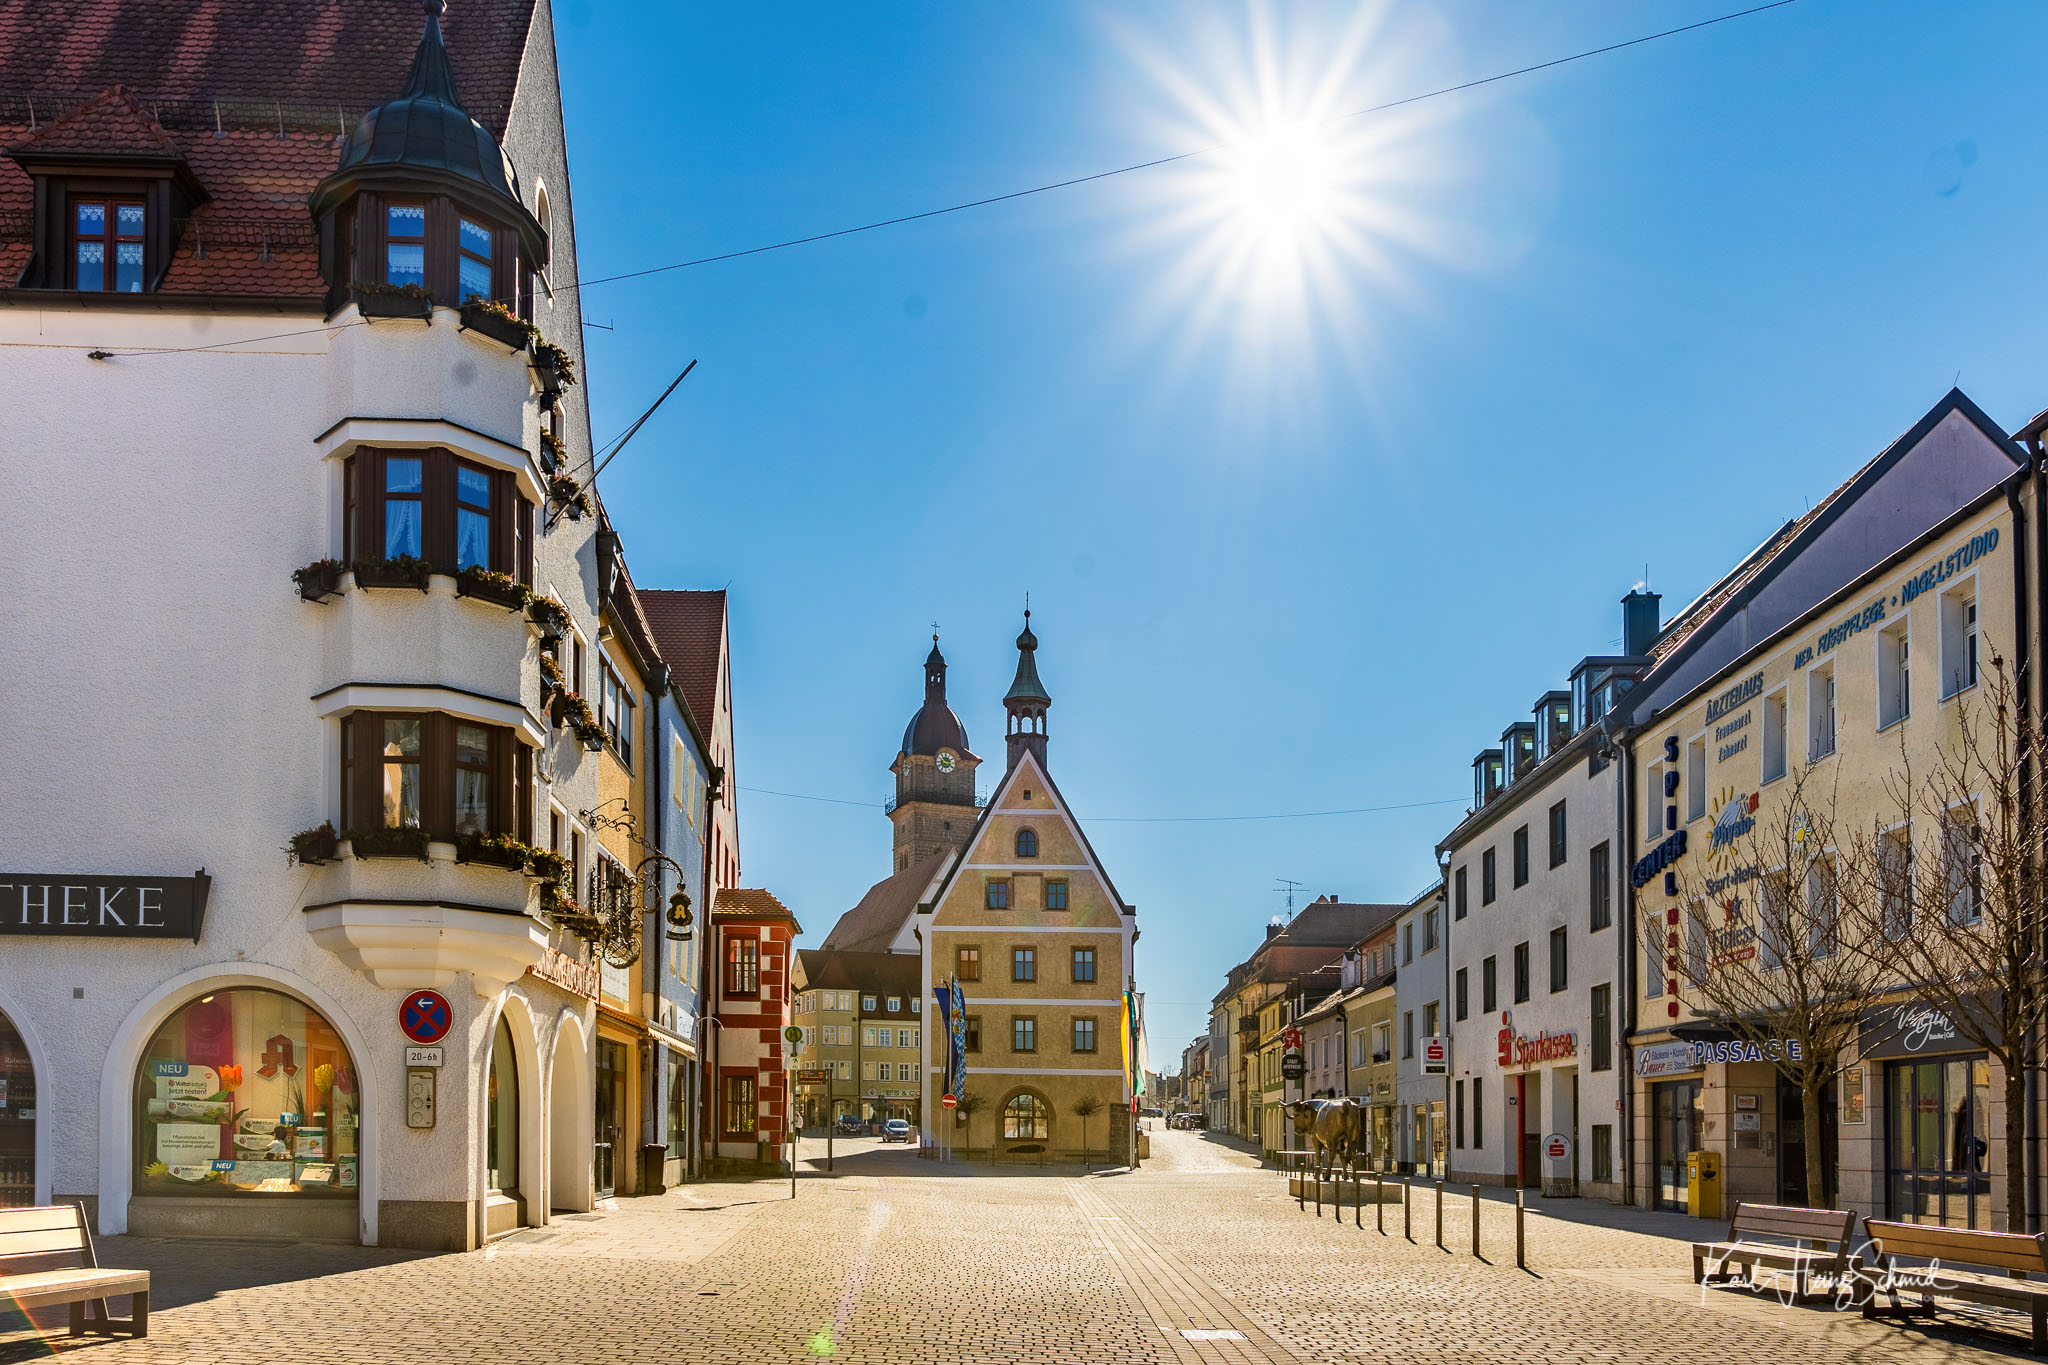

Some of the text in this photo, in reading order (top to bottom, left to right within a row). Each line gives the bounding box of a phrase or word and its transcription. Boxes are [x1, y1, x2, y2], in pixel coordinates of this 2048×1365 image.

[1901, 527, 1999, 606] NAGELSTUDIO
[1516, 1029, 1573, 1071] Sparkasse
[1695, 1039, 1802, 1065] PASSAGE
[159, 1064, 182, 1073] NEU
[284, 1114, 298, 1122] NEU
